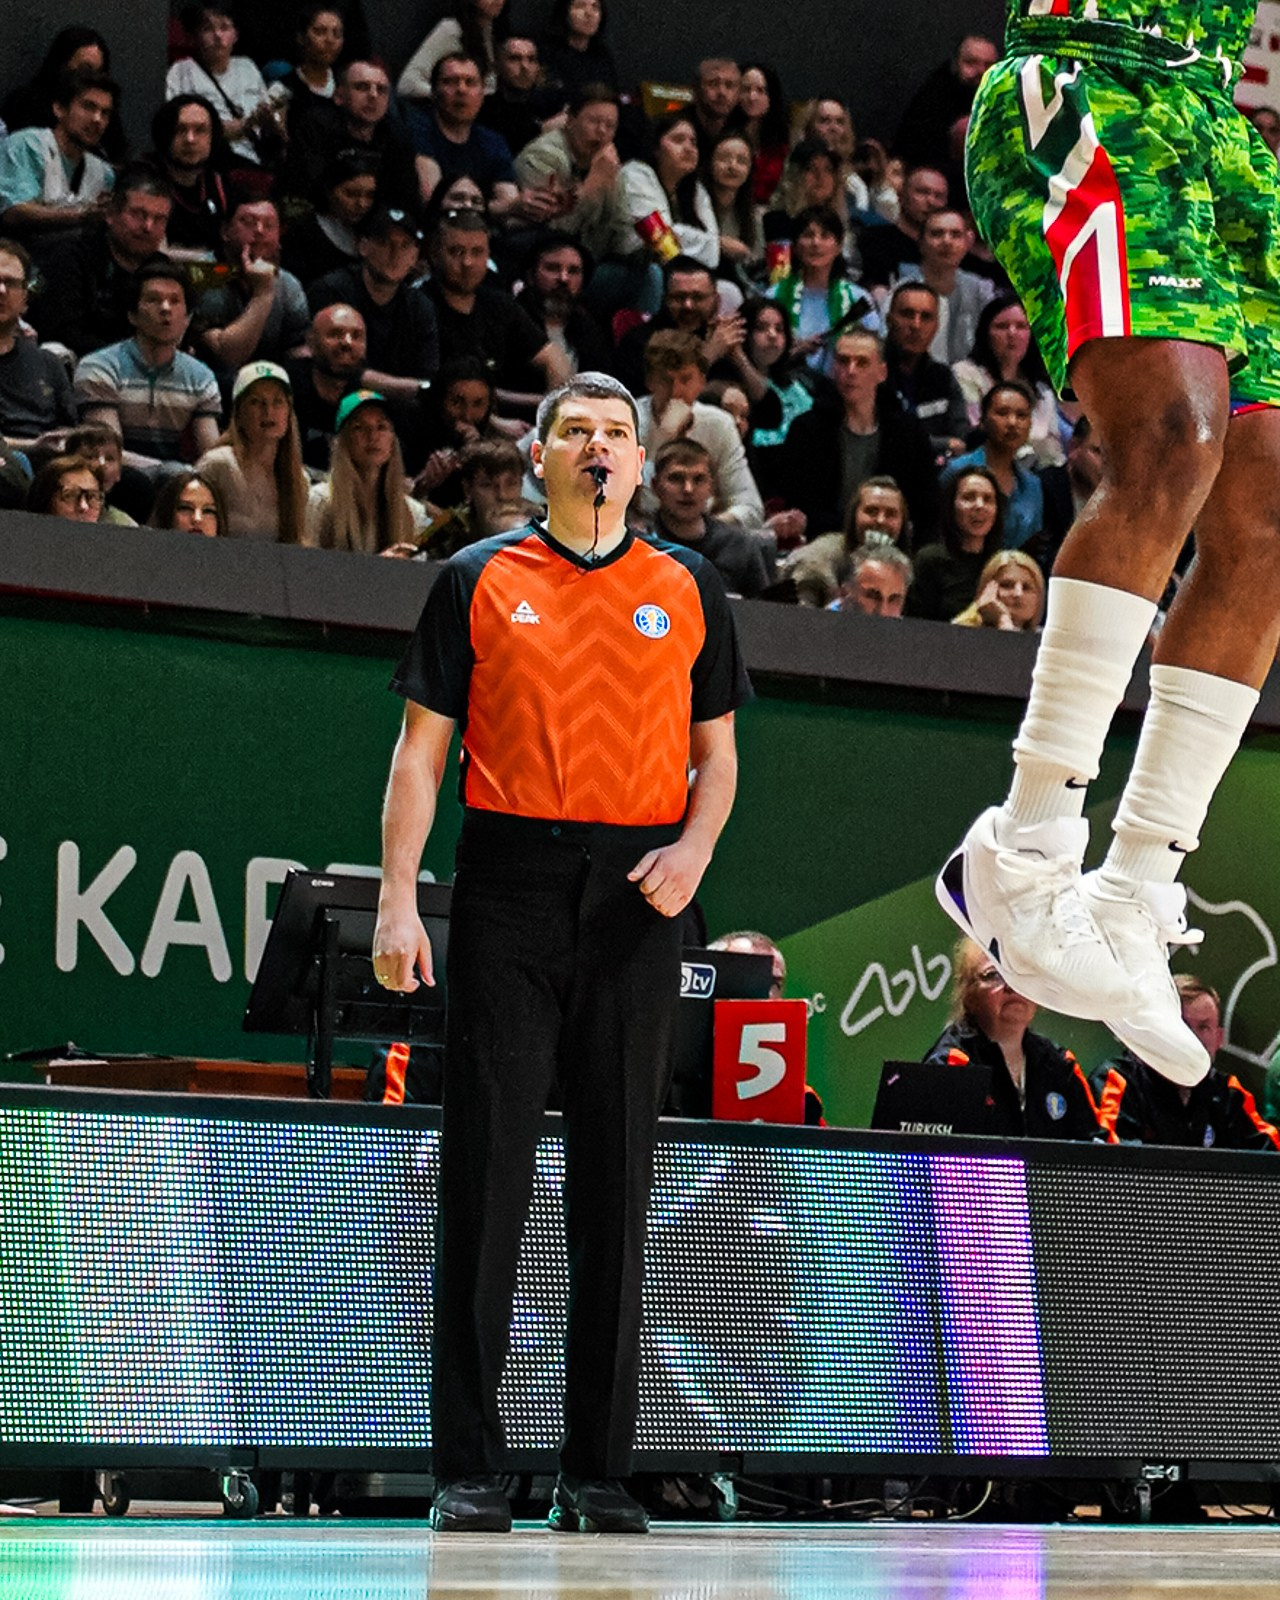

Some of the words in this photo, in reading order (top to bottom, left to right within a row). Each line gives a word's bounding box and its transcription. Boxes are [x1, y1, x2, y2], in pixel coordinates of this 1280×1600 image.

[1148, 275, 1203, 289] MAXX
[736, 1022, 787, 1100] 5
[899, 1121, 954, 1135] TURKISH
